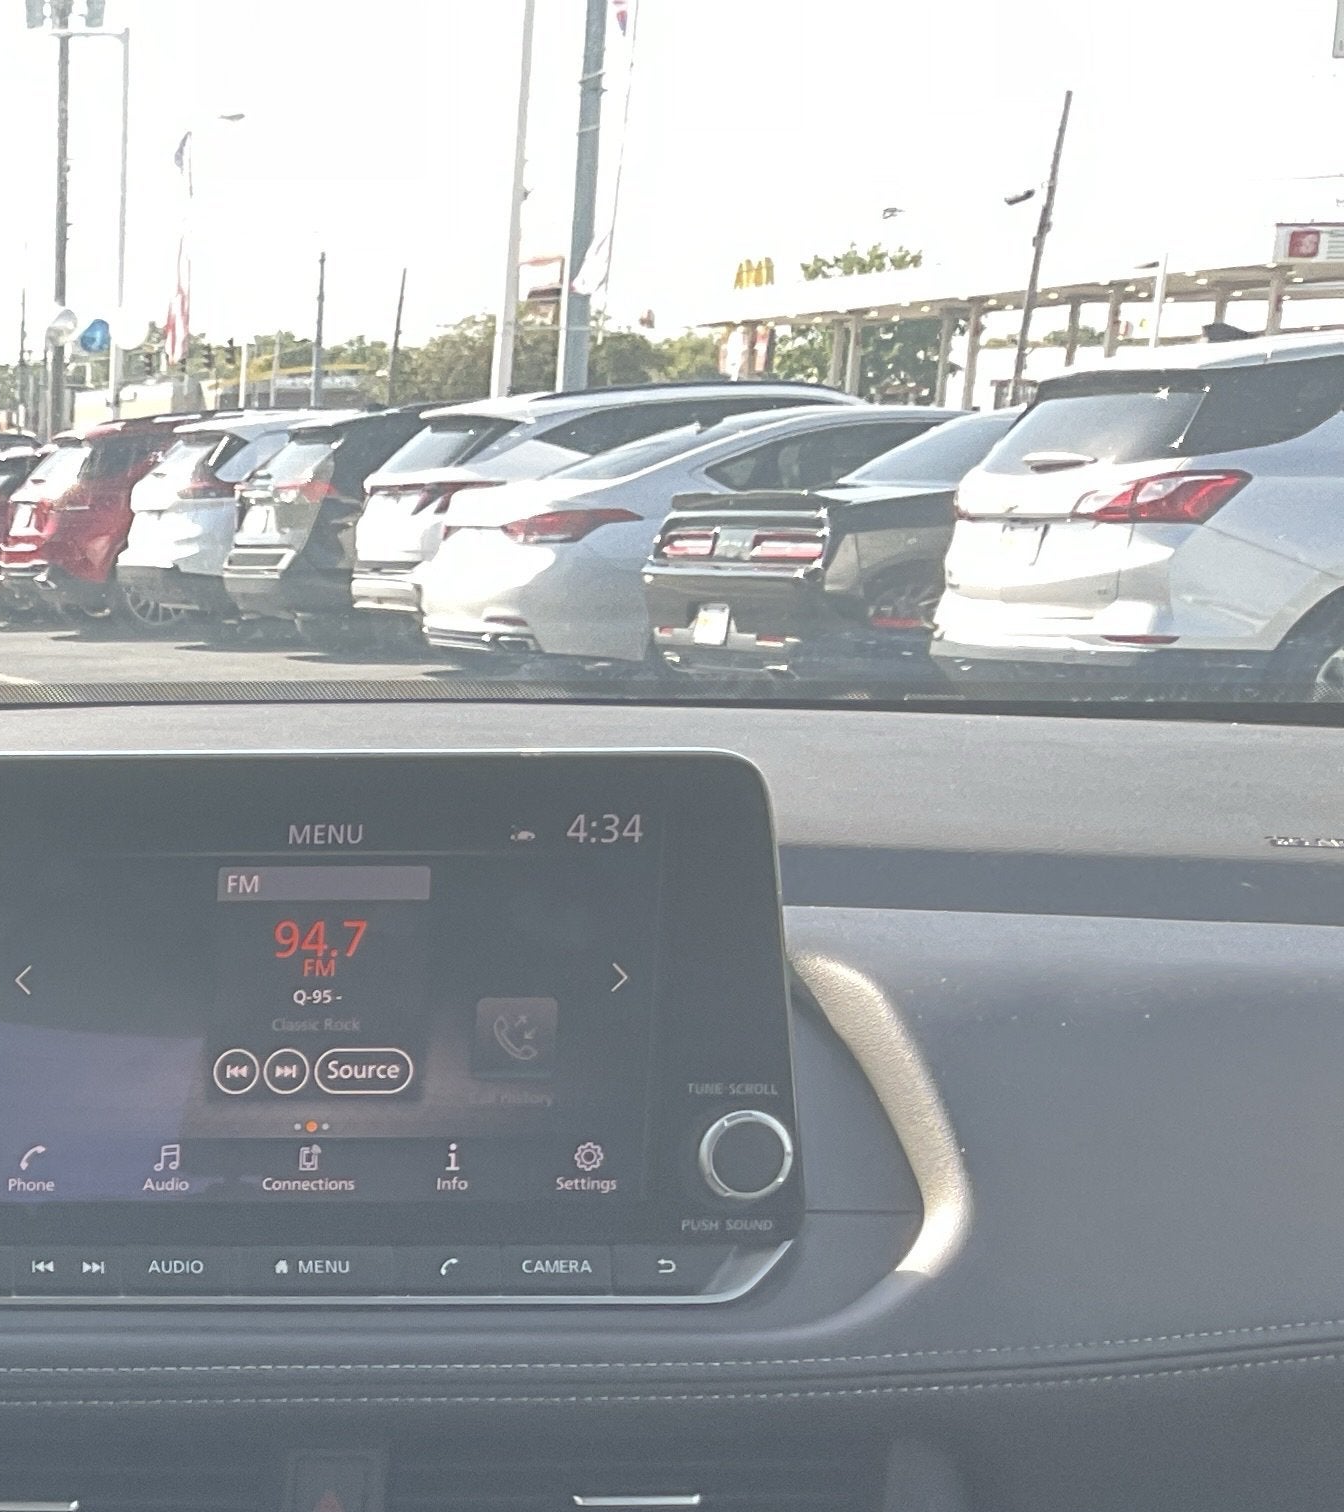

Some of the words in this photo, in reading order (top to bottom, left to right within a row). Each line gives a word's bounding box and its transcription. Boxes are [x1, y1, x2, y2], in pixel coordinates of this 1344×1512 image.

[288, 824, 363, 844] MENU
[566, 814, 644, 843] 4:34
[227, 875, 259, 893] FM
[274, 920, 367, 959] 94.7
[303, 959, 335, 977] FM
[293, 989, 332, 1005] Q-95
[272, 1018, 318, 1032] Classic
[324, 1018, 361, 1032] Rock
[327, 1060, 400, 1079] Source
[8, 1178, 55, 1192] Phone
[143, 1178, 190, 1192] Audio
[262, 1177, 355, 1191] Connections
[436, 1177, 468, 1191] Info
[556, 1177, 617, 1193] Settings
[681, 1219, 719, 1231] PUSH
[148, 1260, 204, 1274] AUDIO
[298, 1260, 350, 1273] MENU
[522, 1259, 592, 1273] CAMERA
